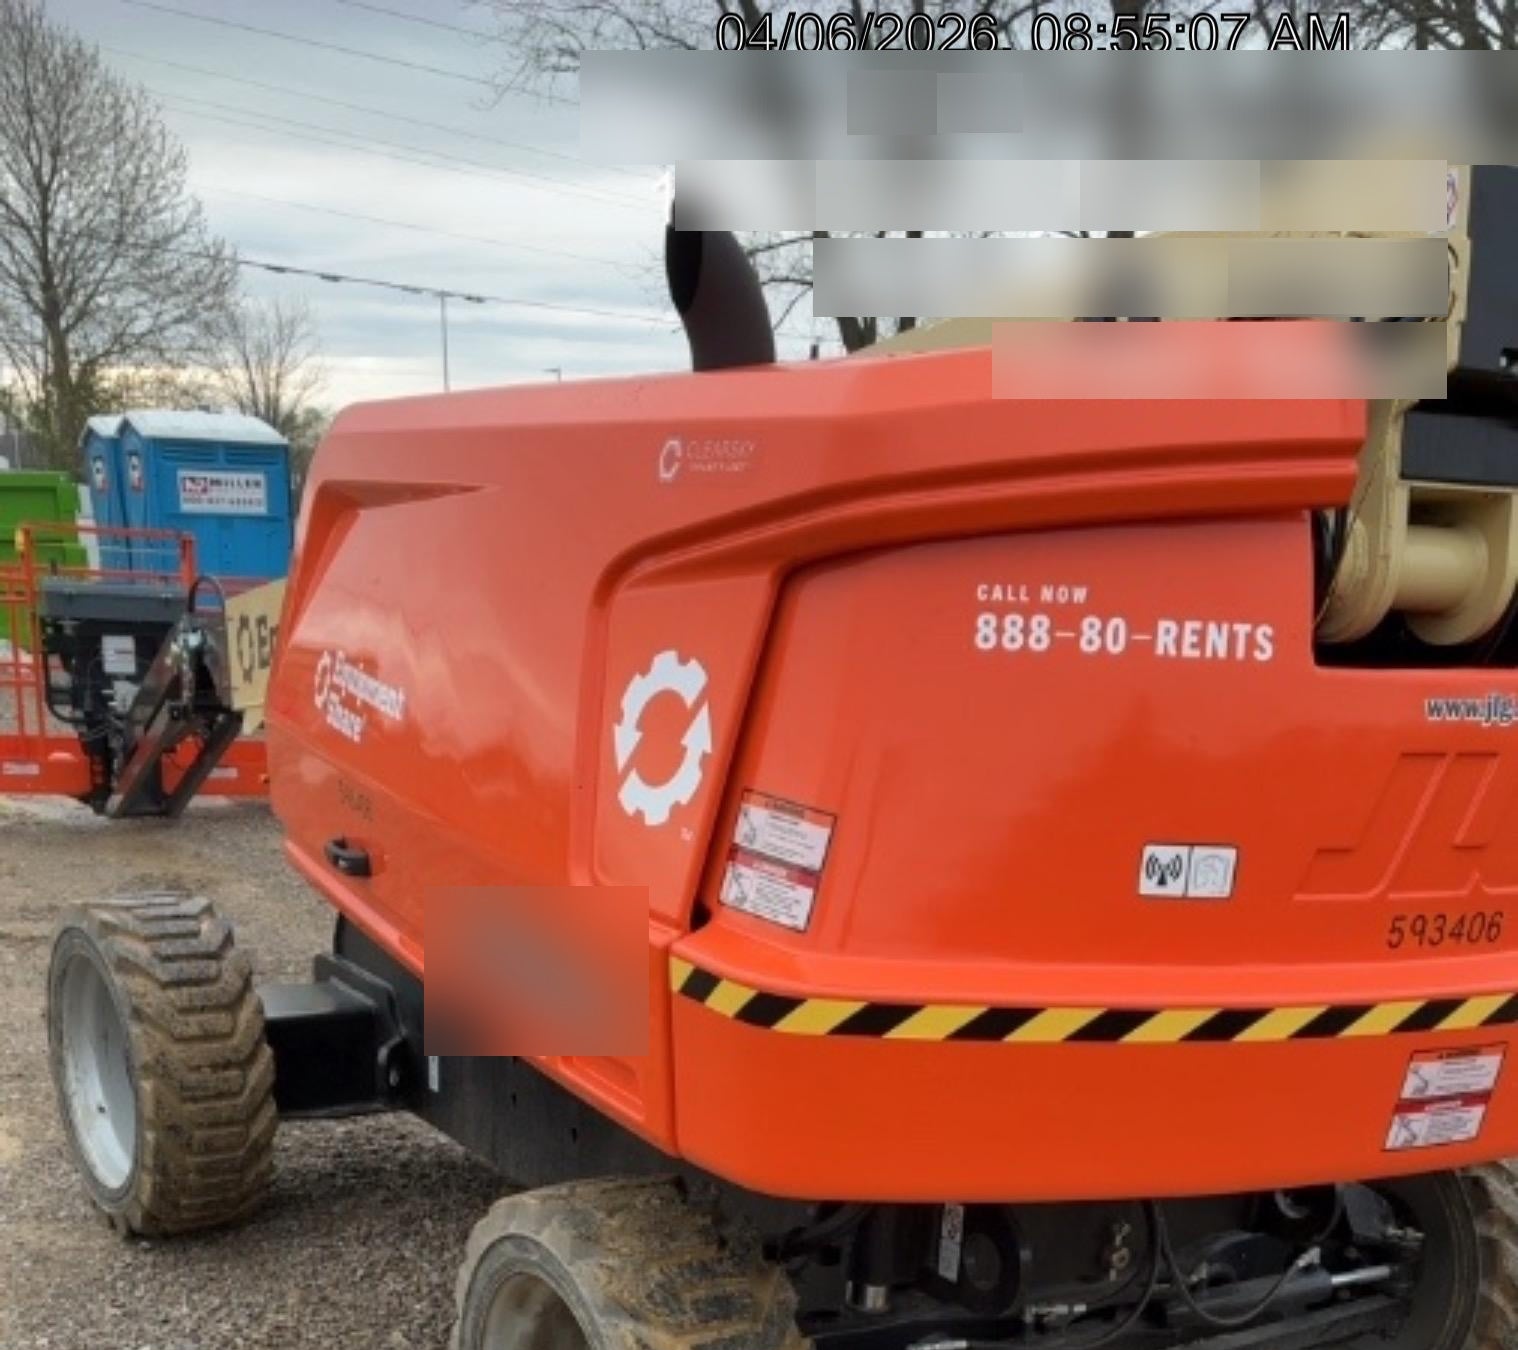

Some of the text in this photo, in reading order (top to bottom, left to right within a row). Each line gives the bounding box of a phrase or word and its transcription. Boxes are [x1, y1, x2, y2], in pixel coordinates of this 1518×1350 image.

[976, 584, 1088, 604] CALL NOW
[974, 612, 1275, 662] 888-80-RENTS
[333, 650, 405, 720] Equipment
[326, 691, 365, 743] Share
[1386, 911, 1503, 950] 593406
